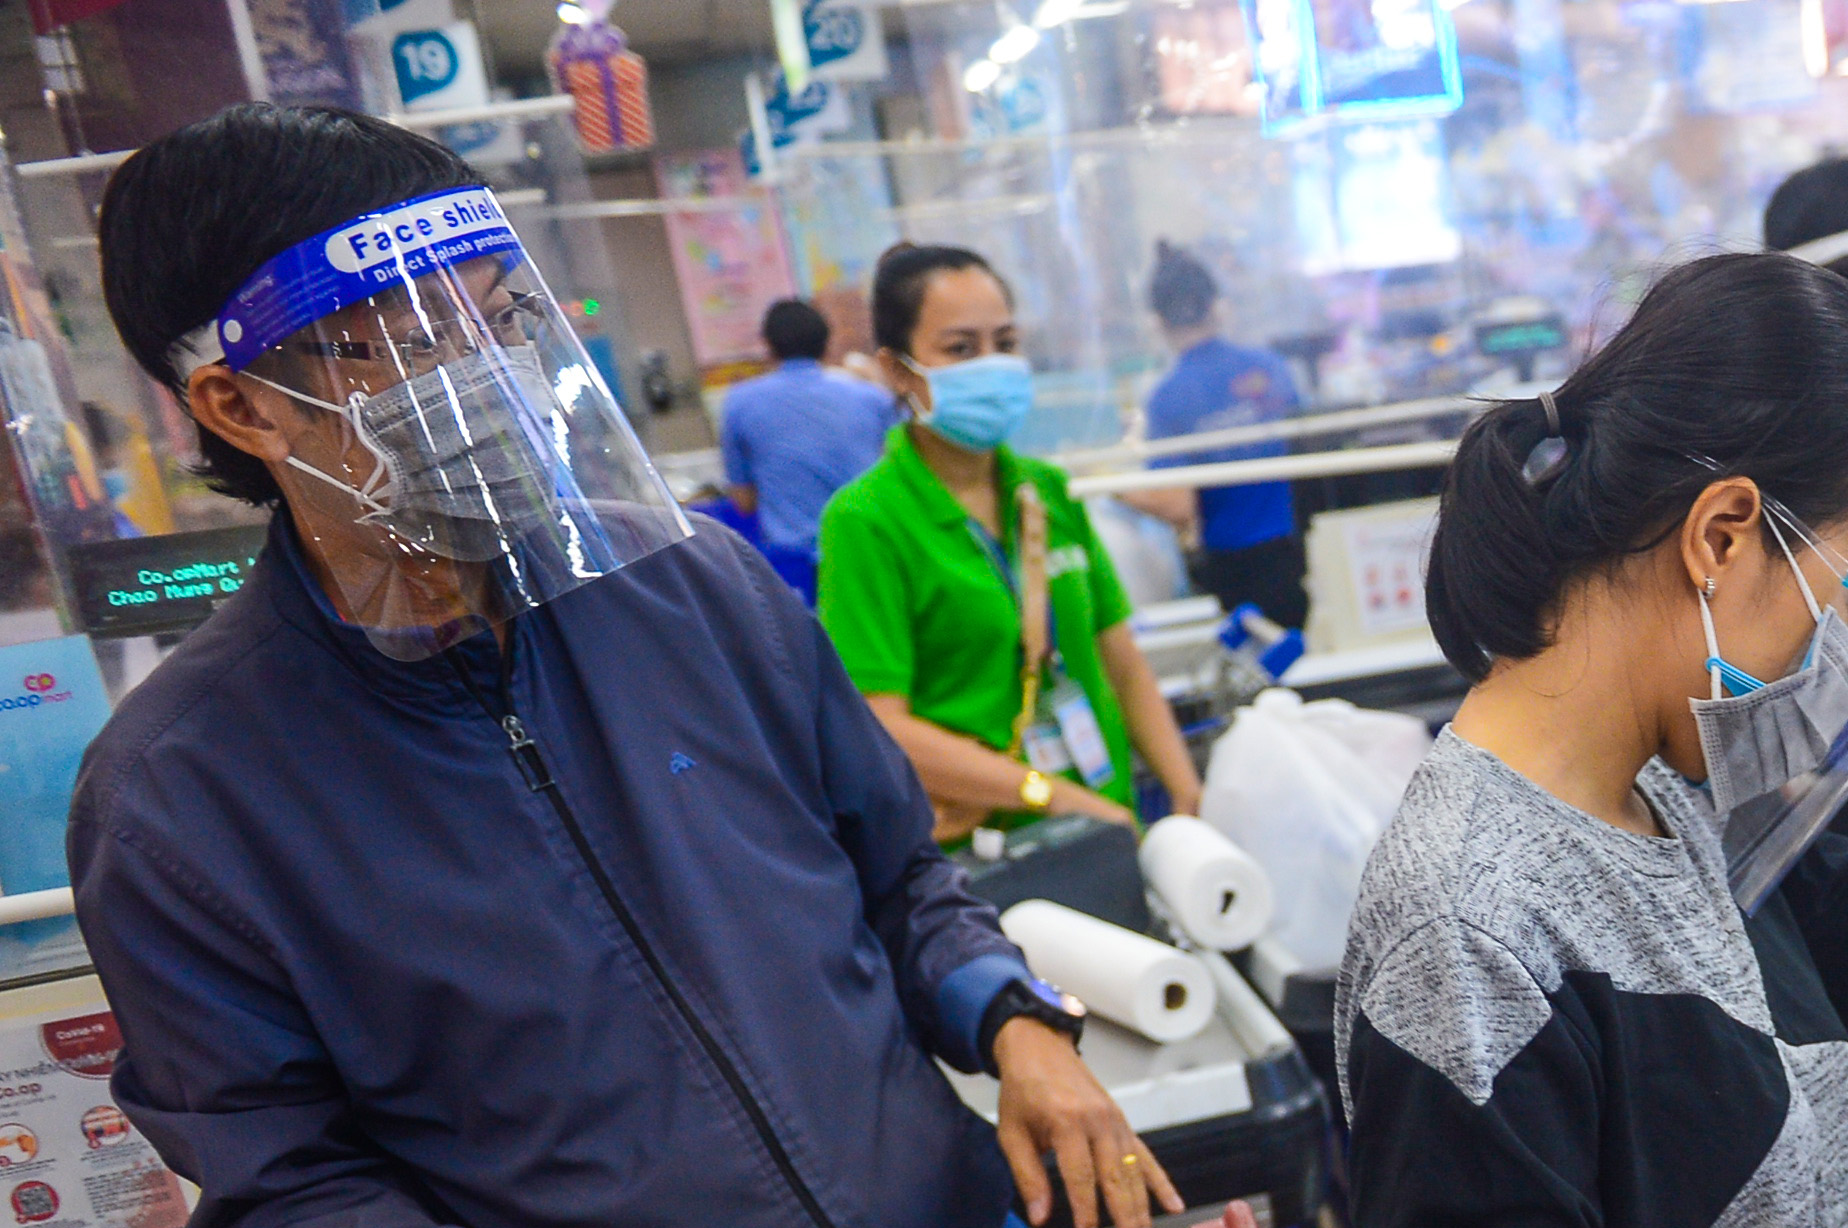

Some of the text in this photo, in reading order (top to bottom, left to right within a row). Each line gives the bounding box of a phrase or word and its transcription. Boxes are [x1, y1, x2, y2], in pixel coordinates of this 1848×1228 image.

[402, 40, 451, 81] 19
[349, 217, 433, 260] Face
[108, 590, 158, 606] Chao
